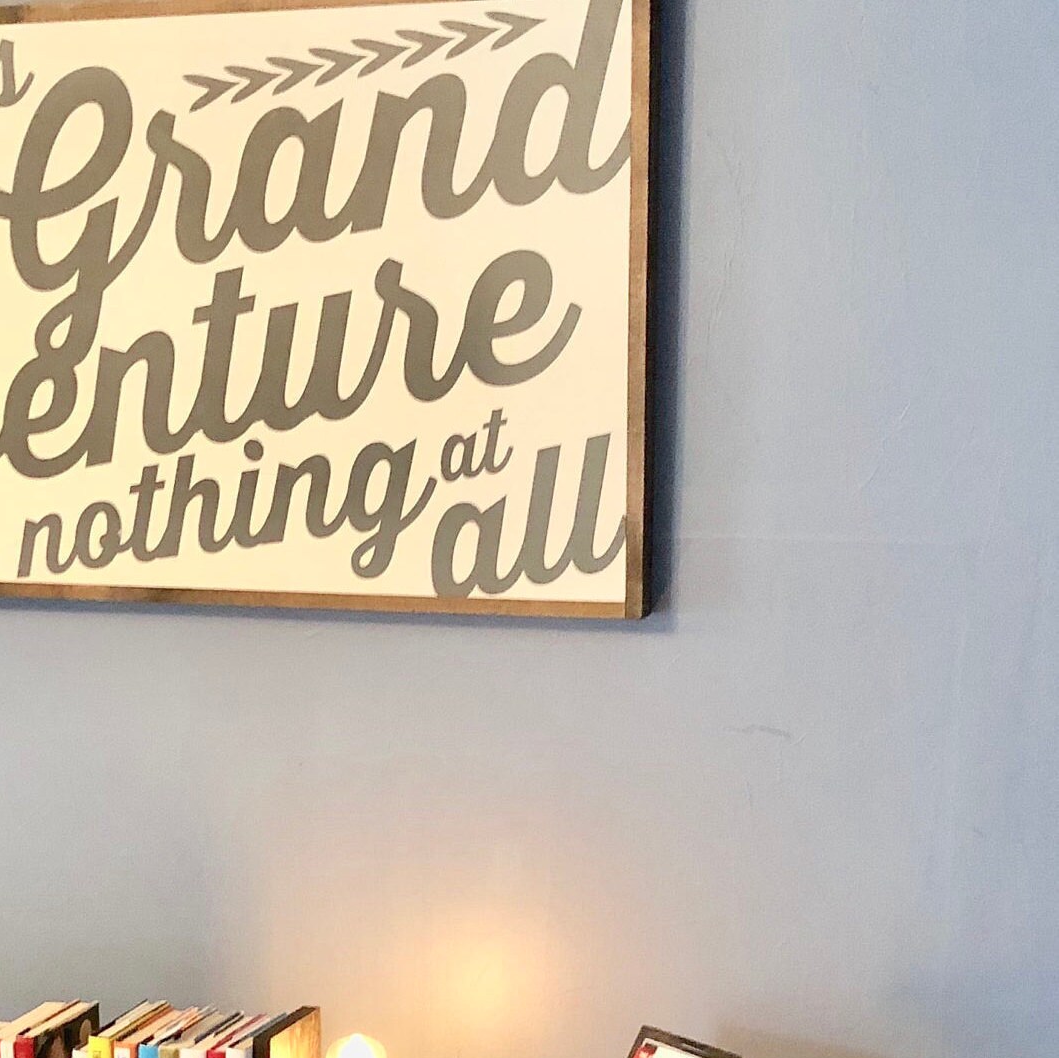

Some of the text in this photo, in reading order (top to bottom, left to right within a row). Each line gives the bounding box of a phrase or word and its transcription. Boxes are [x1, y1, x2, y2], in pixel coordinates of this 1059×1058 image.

[17, 438, 437, 580] nothing
[430, 432, 627, 599] all
[441, 408, 513, 482] at
